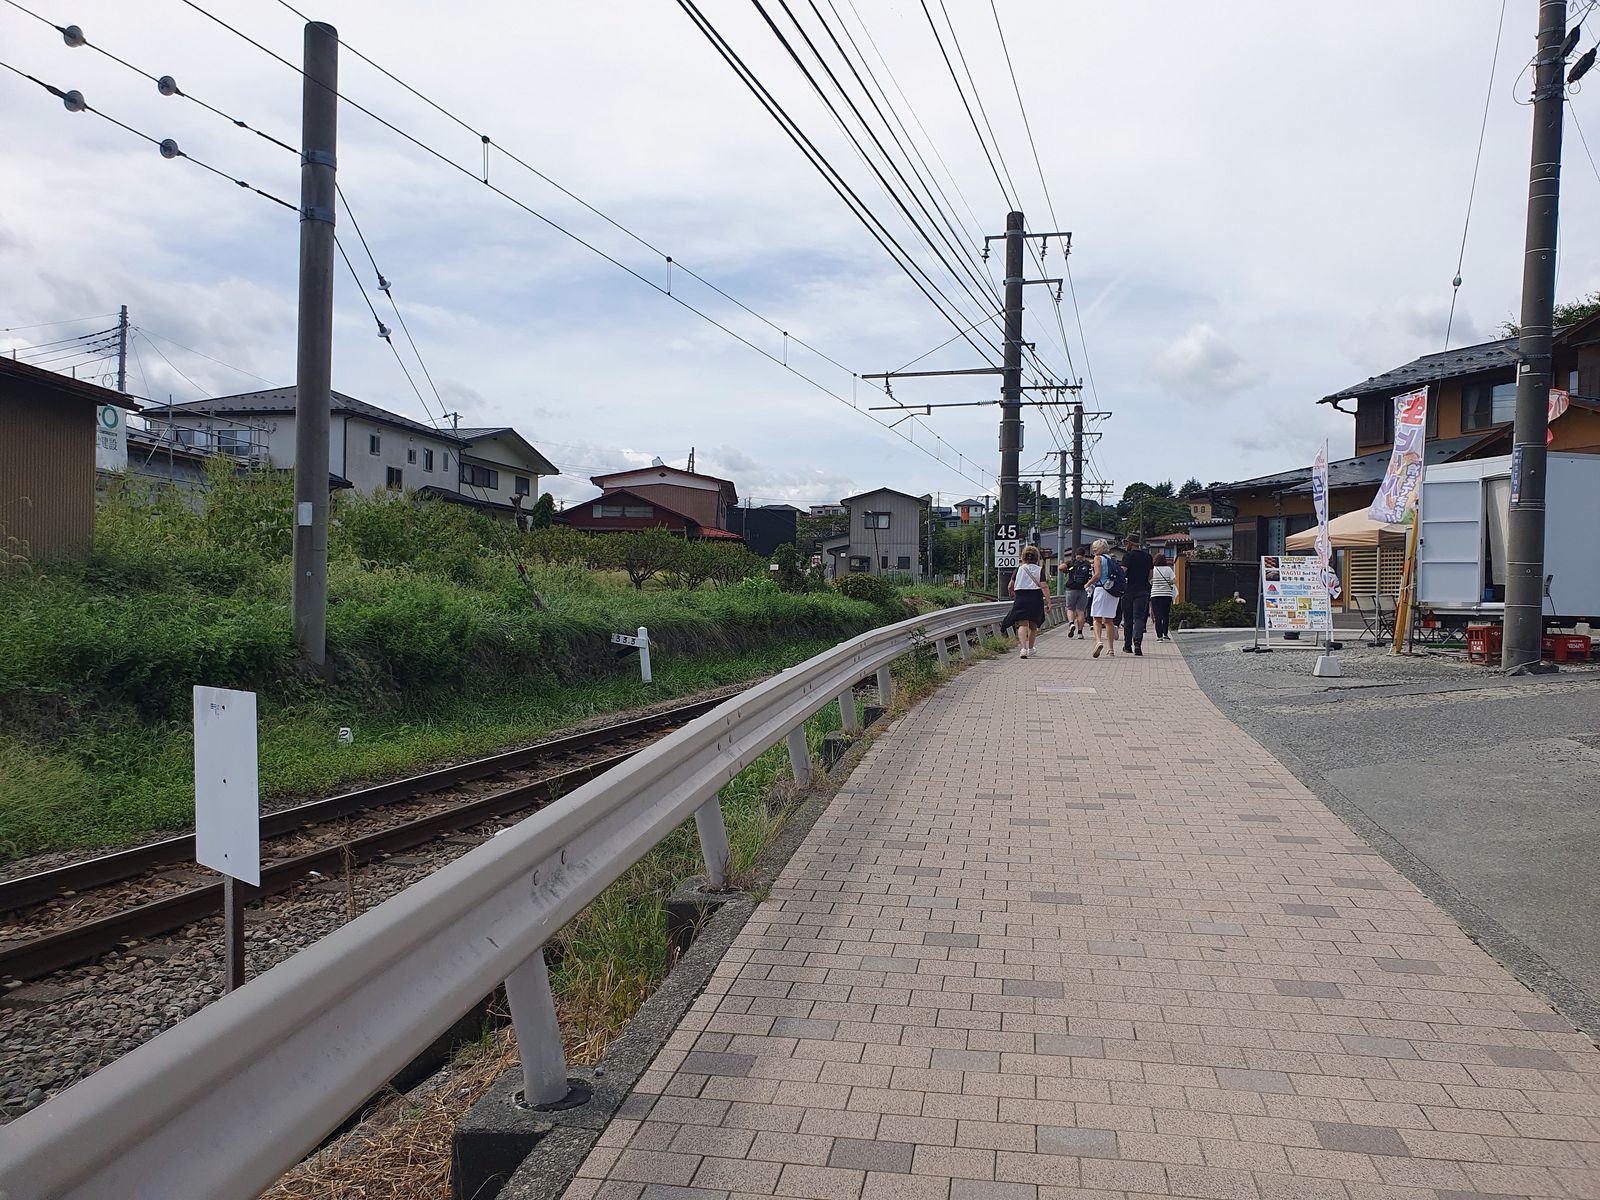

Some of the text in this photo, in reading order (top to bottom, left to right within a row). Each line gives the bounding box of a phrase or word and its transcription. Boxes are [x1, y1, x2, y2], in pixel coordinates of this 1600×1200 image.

[997, 525, 1017, 539] 45
[997, 541, 1017, 555] 45
[998, 557, 1016, 567] 200
